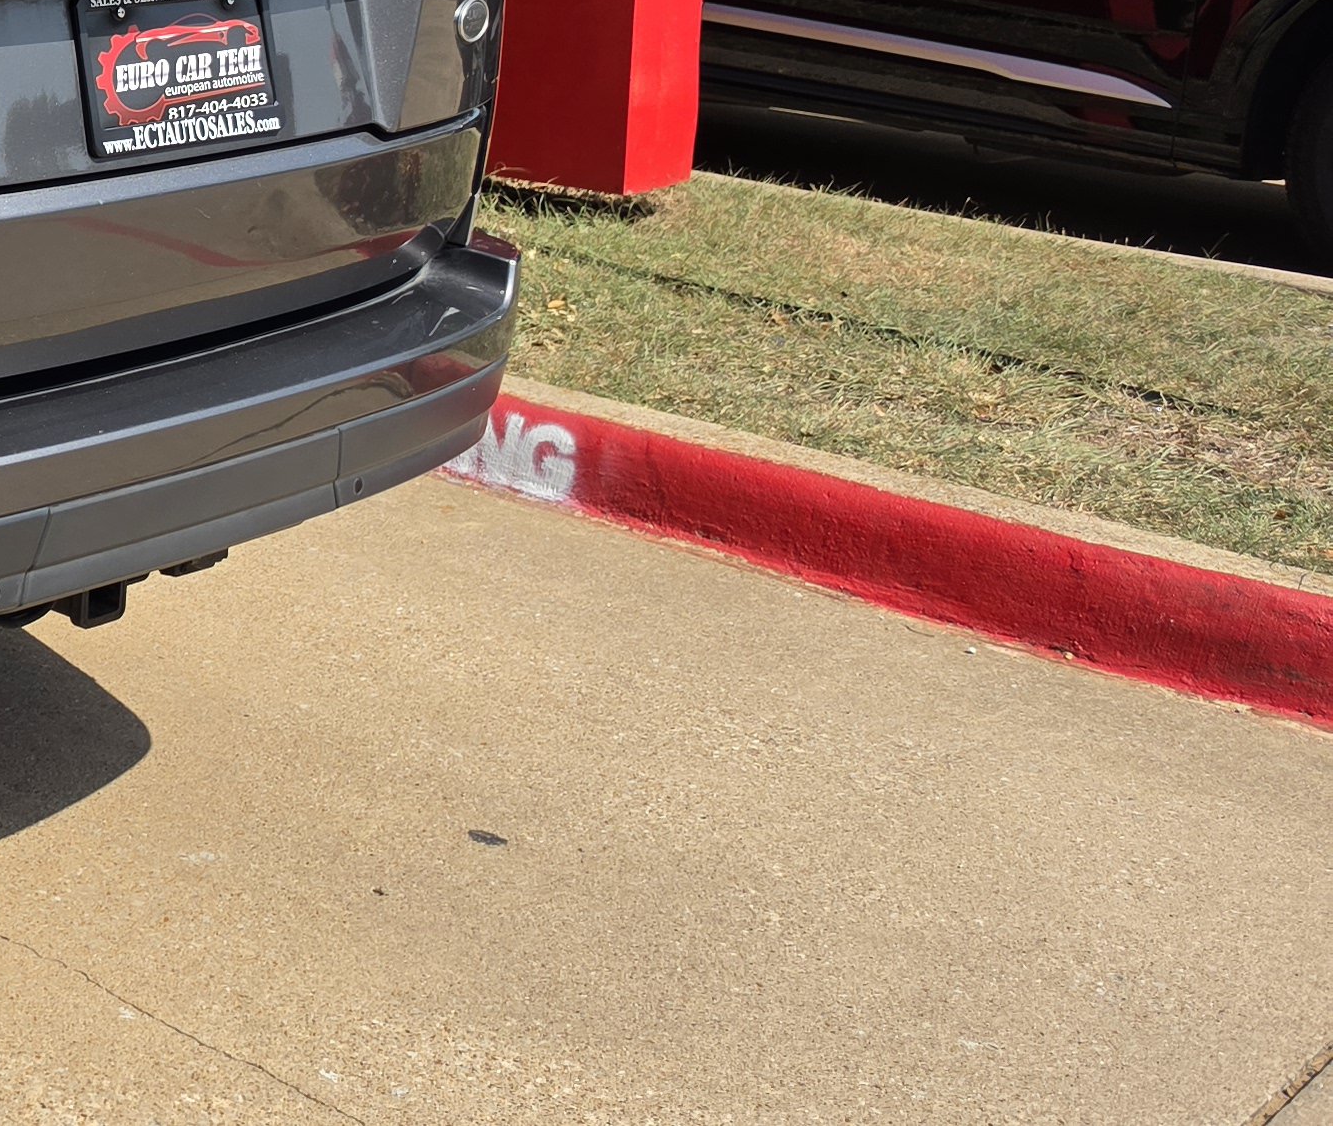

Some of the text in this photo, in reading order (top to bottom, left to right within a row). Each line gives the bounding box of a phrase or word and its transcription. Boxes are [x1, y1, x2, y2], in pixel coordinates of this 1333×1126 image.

[115, 44, 262, 93] EURO CAR TECH
[164, 71, 264, 97] european automotive
[168, 92, 268, 120] 817-404-4033
[102, 110, 281, 155] www.ECTAUTOSALES.com
[443, 410, 577, 502] NG
